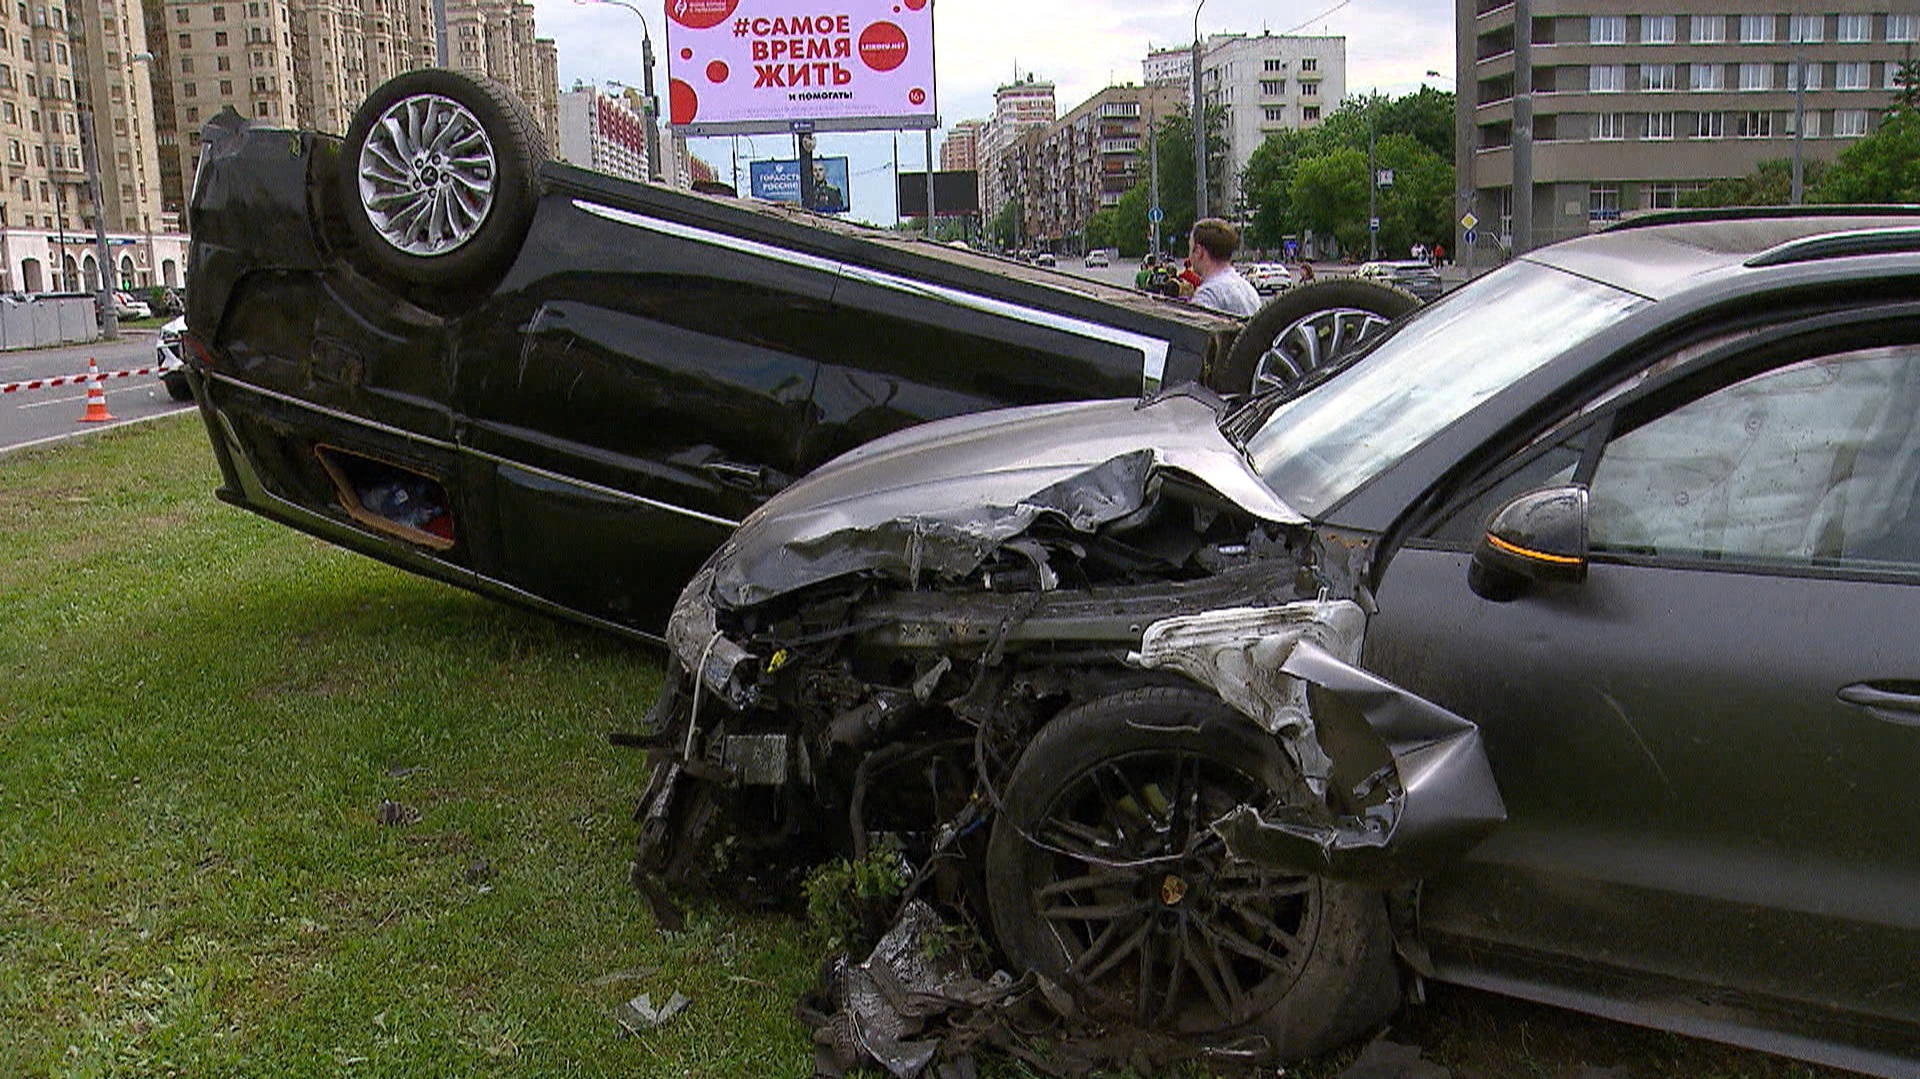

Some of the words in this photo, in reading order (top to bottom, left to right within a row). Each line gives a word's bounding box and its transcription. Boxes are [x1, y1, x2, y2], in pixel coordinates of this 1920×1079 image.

[733, 15, 850, 37] #САМОЕ
[752, 37, 851, 61] ВРЕМЯ
[753, 62, 852, 89] ЖИТЬ
